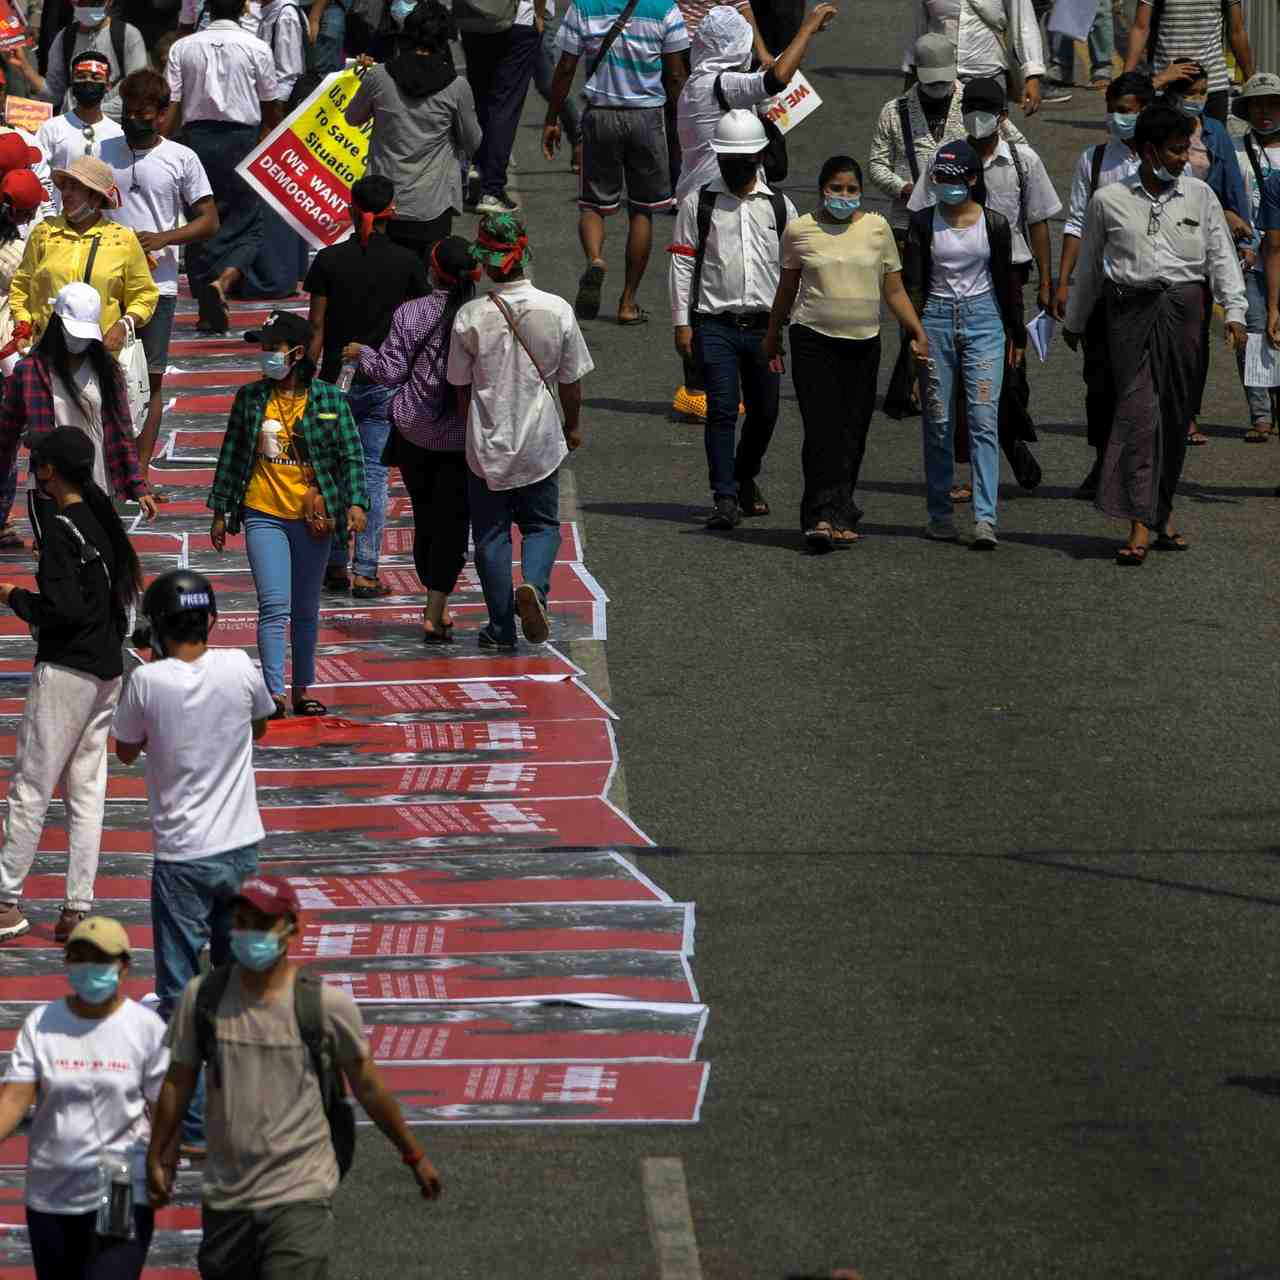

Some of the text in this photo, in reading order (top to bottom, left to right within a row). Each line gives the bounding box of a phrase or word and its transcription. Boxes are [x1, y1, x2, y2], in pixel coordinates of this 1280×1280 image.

[305, 132, 355, 183] Situatio
[315, 107, 360, 157] To Save
[259, 156, 340, 236] DEMOCRACY)
[281, 148, 351, 213] (WE WANT
[180, 592, 210, 608] PRESS
